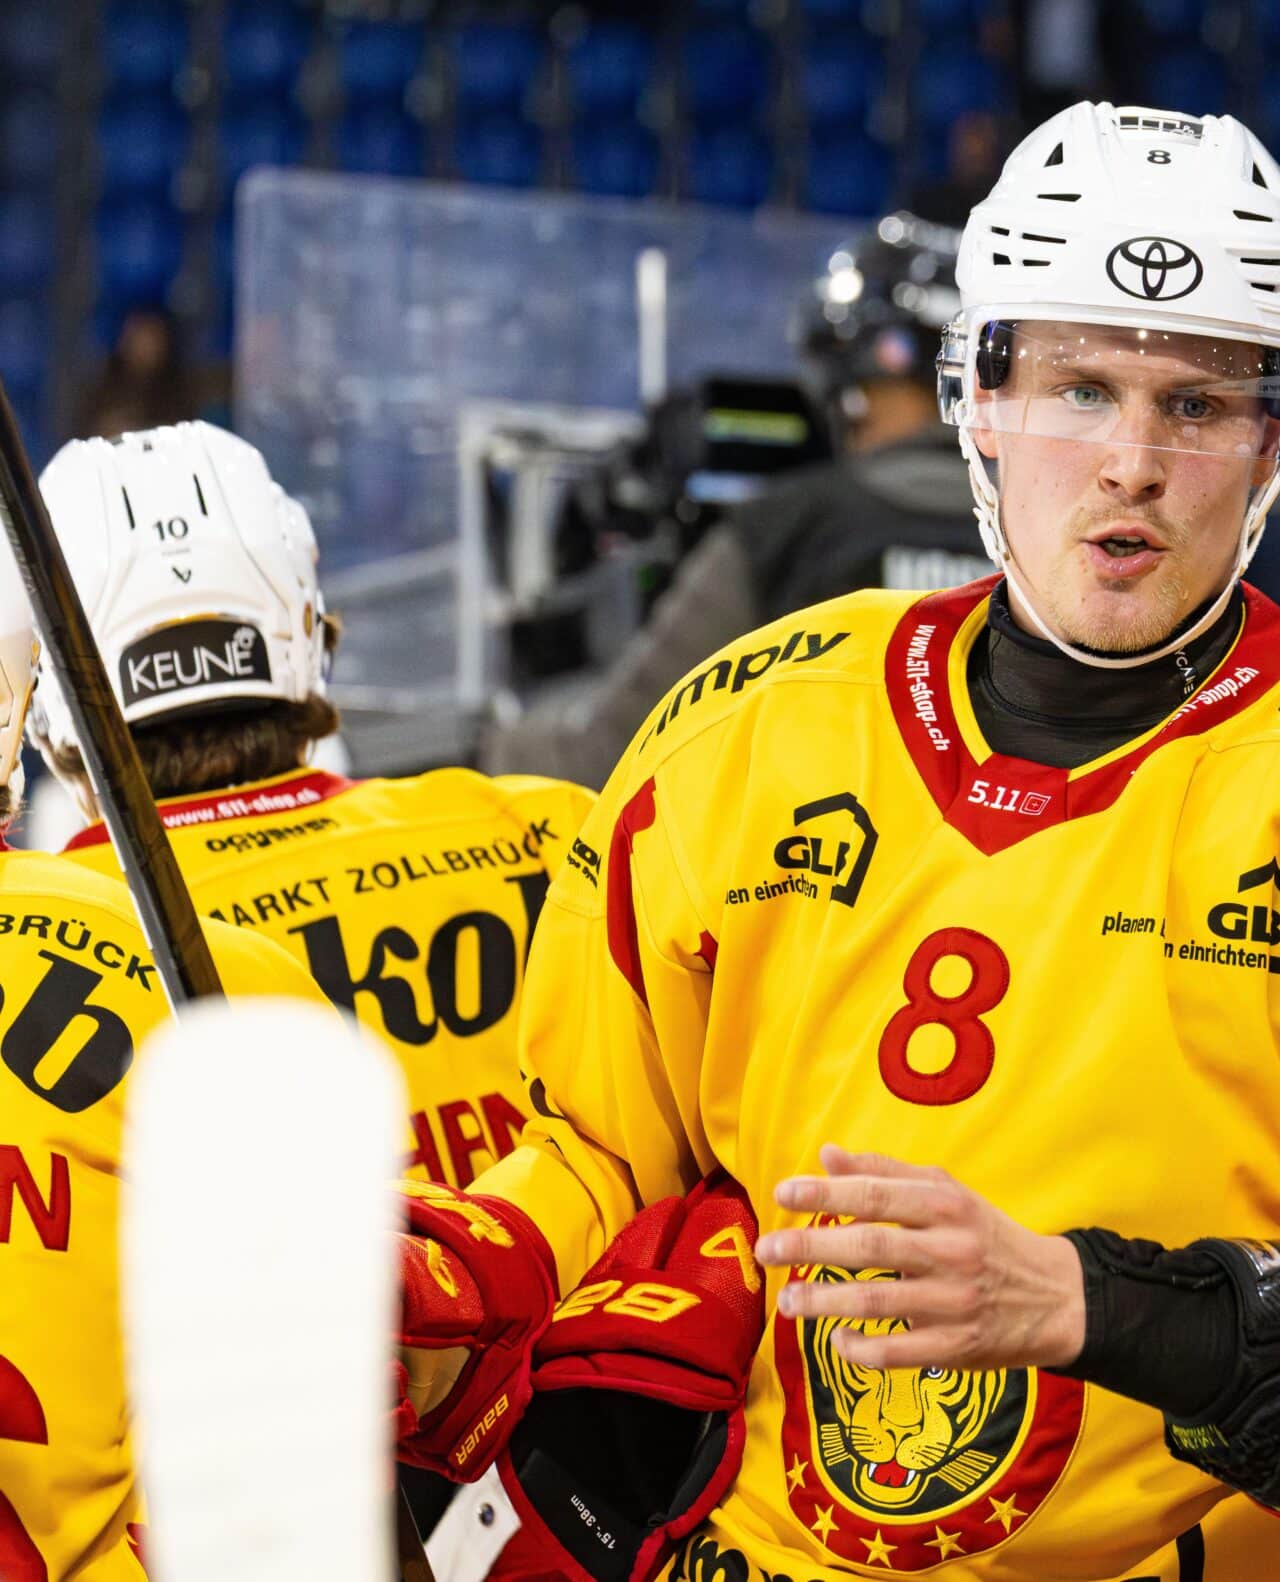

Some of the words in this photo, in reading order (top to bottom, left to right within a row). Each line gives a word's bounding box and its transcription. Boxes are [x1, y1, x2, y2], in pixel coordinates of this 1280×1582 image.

[1146, 149, 1172, 165] 8
[154, 516, 188, 541] 10
[128, 640, 254, 694] KEUNE
[639, 630, 851, 755] imply
[905, 623, 951, 751] www.511-shop.ch
[968, 780, 1021, 811] 5.11
[346, 819, 560, 895] ZOLLBRÜCK
[725, 888, 750, 904] en
[1101, 911, 1156, 936] planen
[1178, 939, 1267, 969] einrichten
[878, 926, 1010, 1107] 8
[570, 1494, 597, 1527] 38cm
